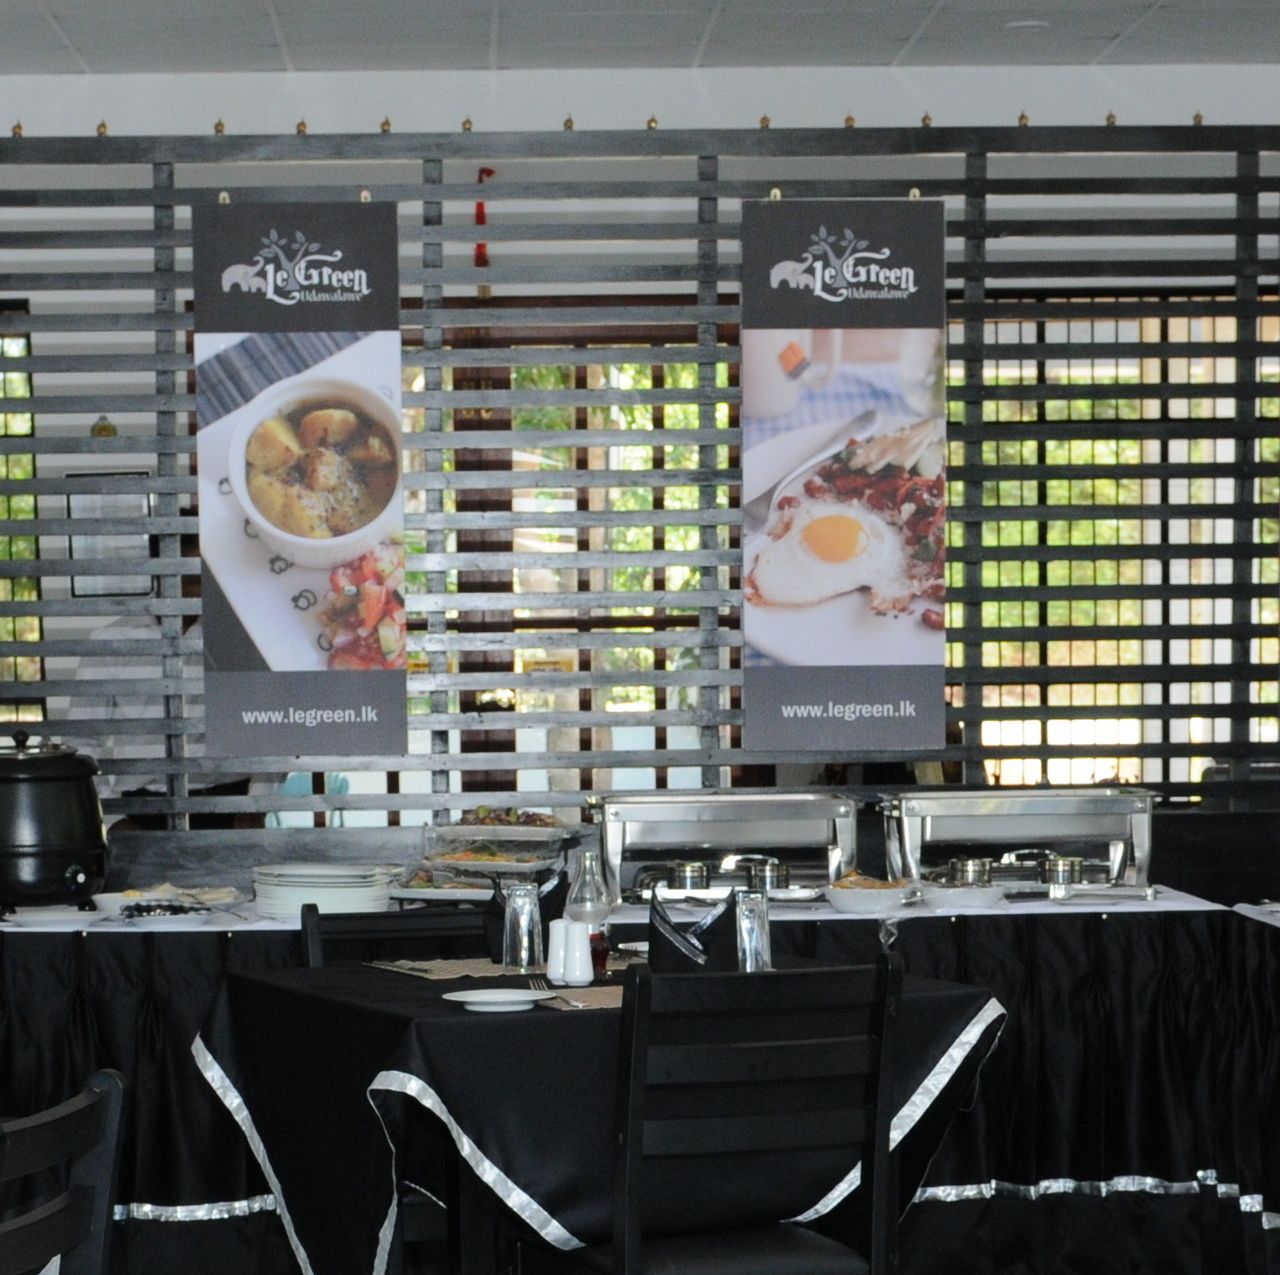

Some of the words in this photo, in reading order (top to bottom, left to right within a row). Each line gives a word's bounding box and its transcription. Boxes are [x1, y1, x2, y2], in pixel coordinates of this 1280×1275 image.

[295, 250, 372, 294] Green
[842, 247, 919, 293] Green
[241, 705, 379, 727] www.legreen.lk
[781, 700, 916, 721] www.legreen.lk
